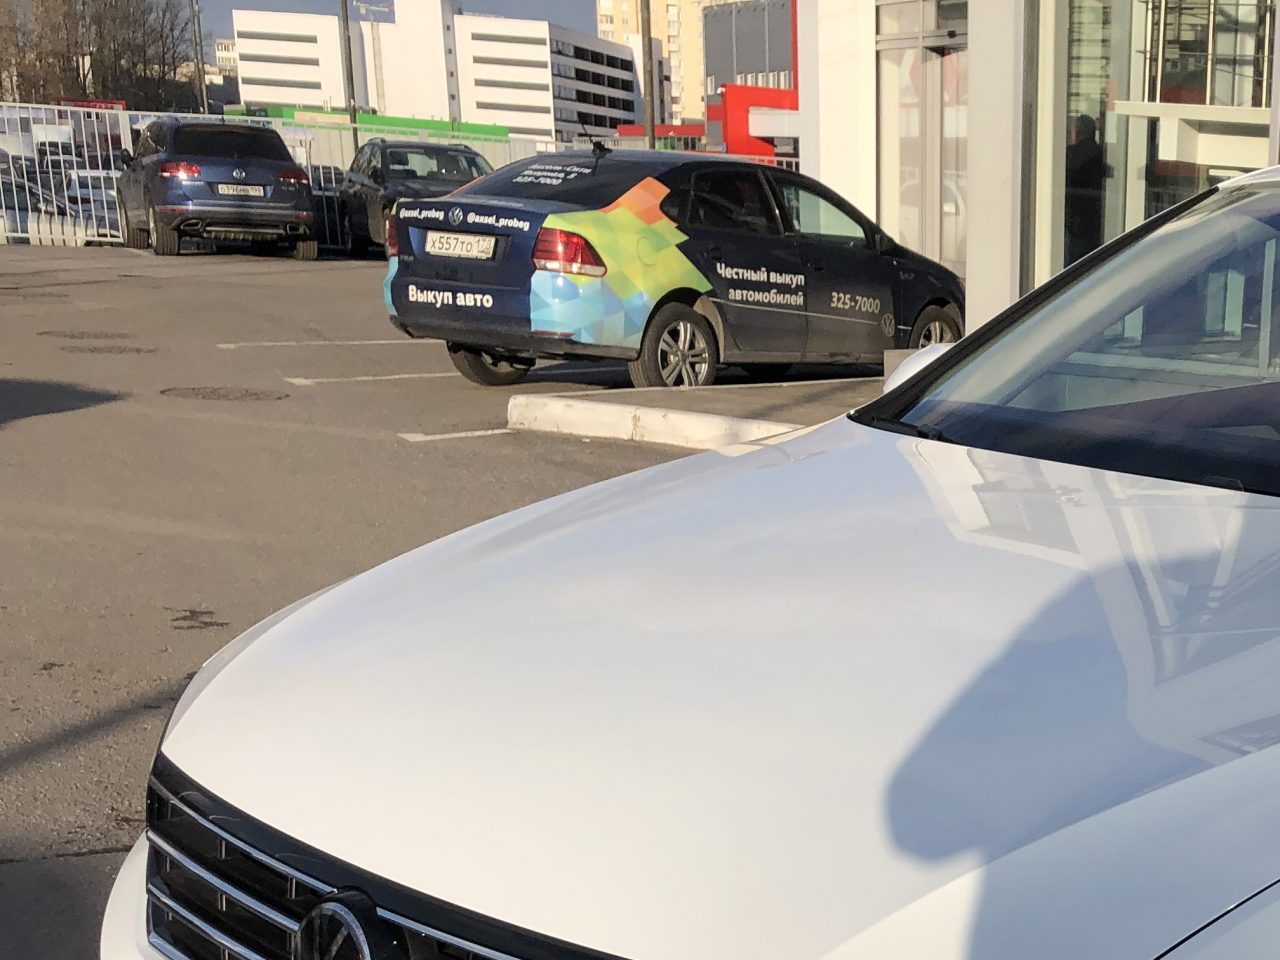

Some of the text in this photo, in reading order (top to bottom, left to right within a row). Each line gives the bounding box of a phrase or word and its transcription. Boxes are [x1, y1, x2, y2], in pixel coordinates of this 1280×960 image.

[467, 212, 530, 231] @axsel_probeg
[716, 262, 805, 289] Честный выкуп
[408, 284, 494, 308] Выкуп авто
[728, 288, 804, 307] автомобилей
[830, 292, 881, 313] 325-7000
